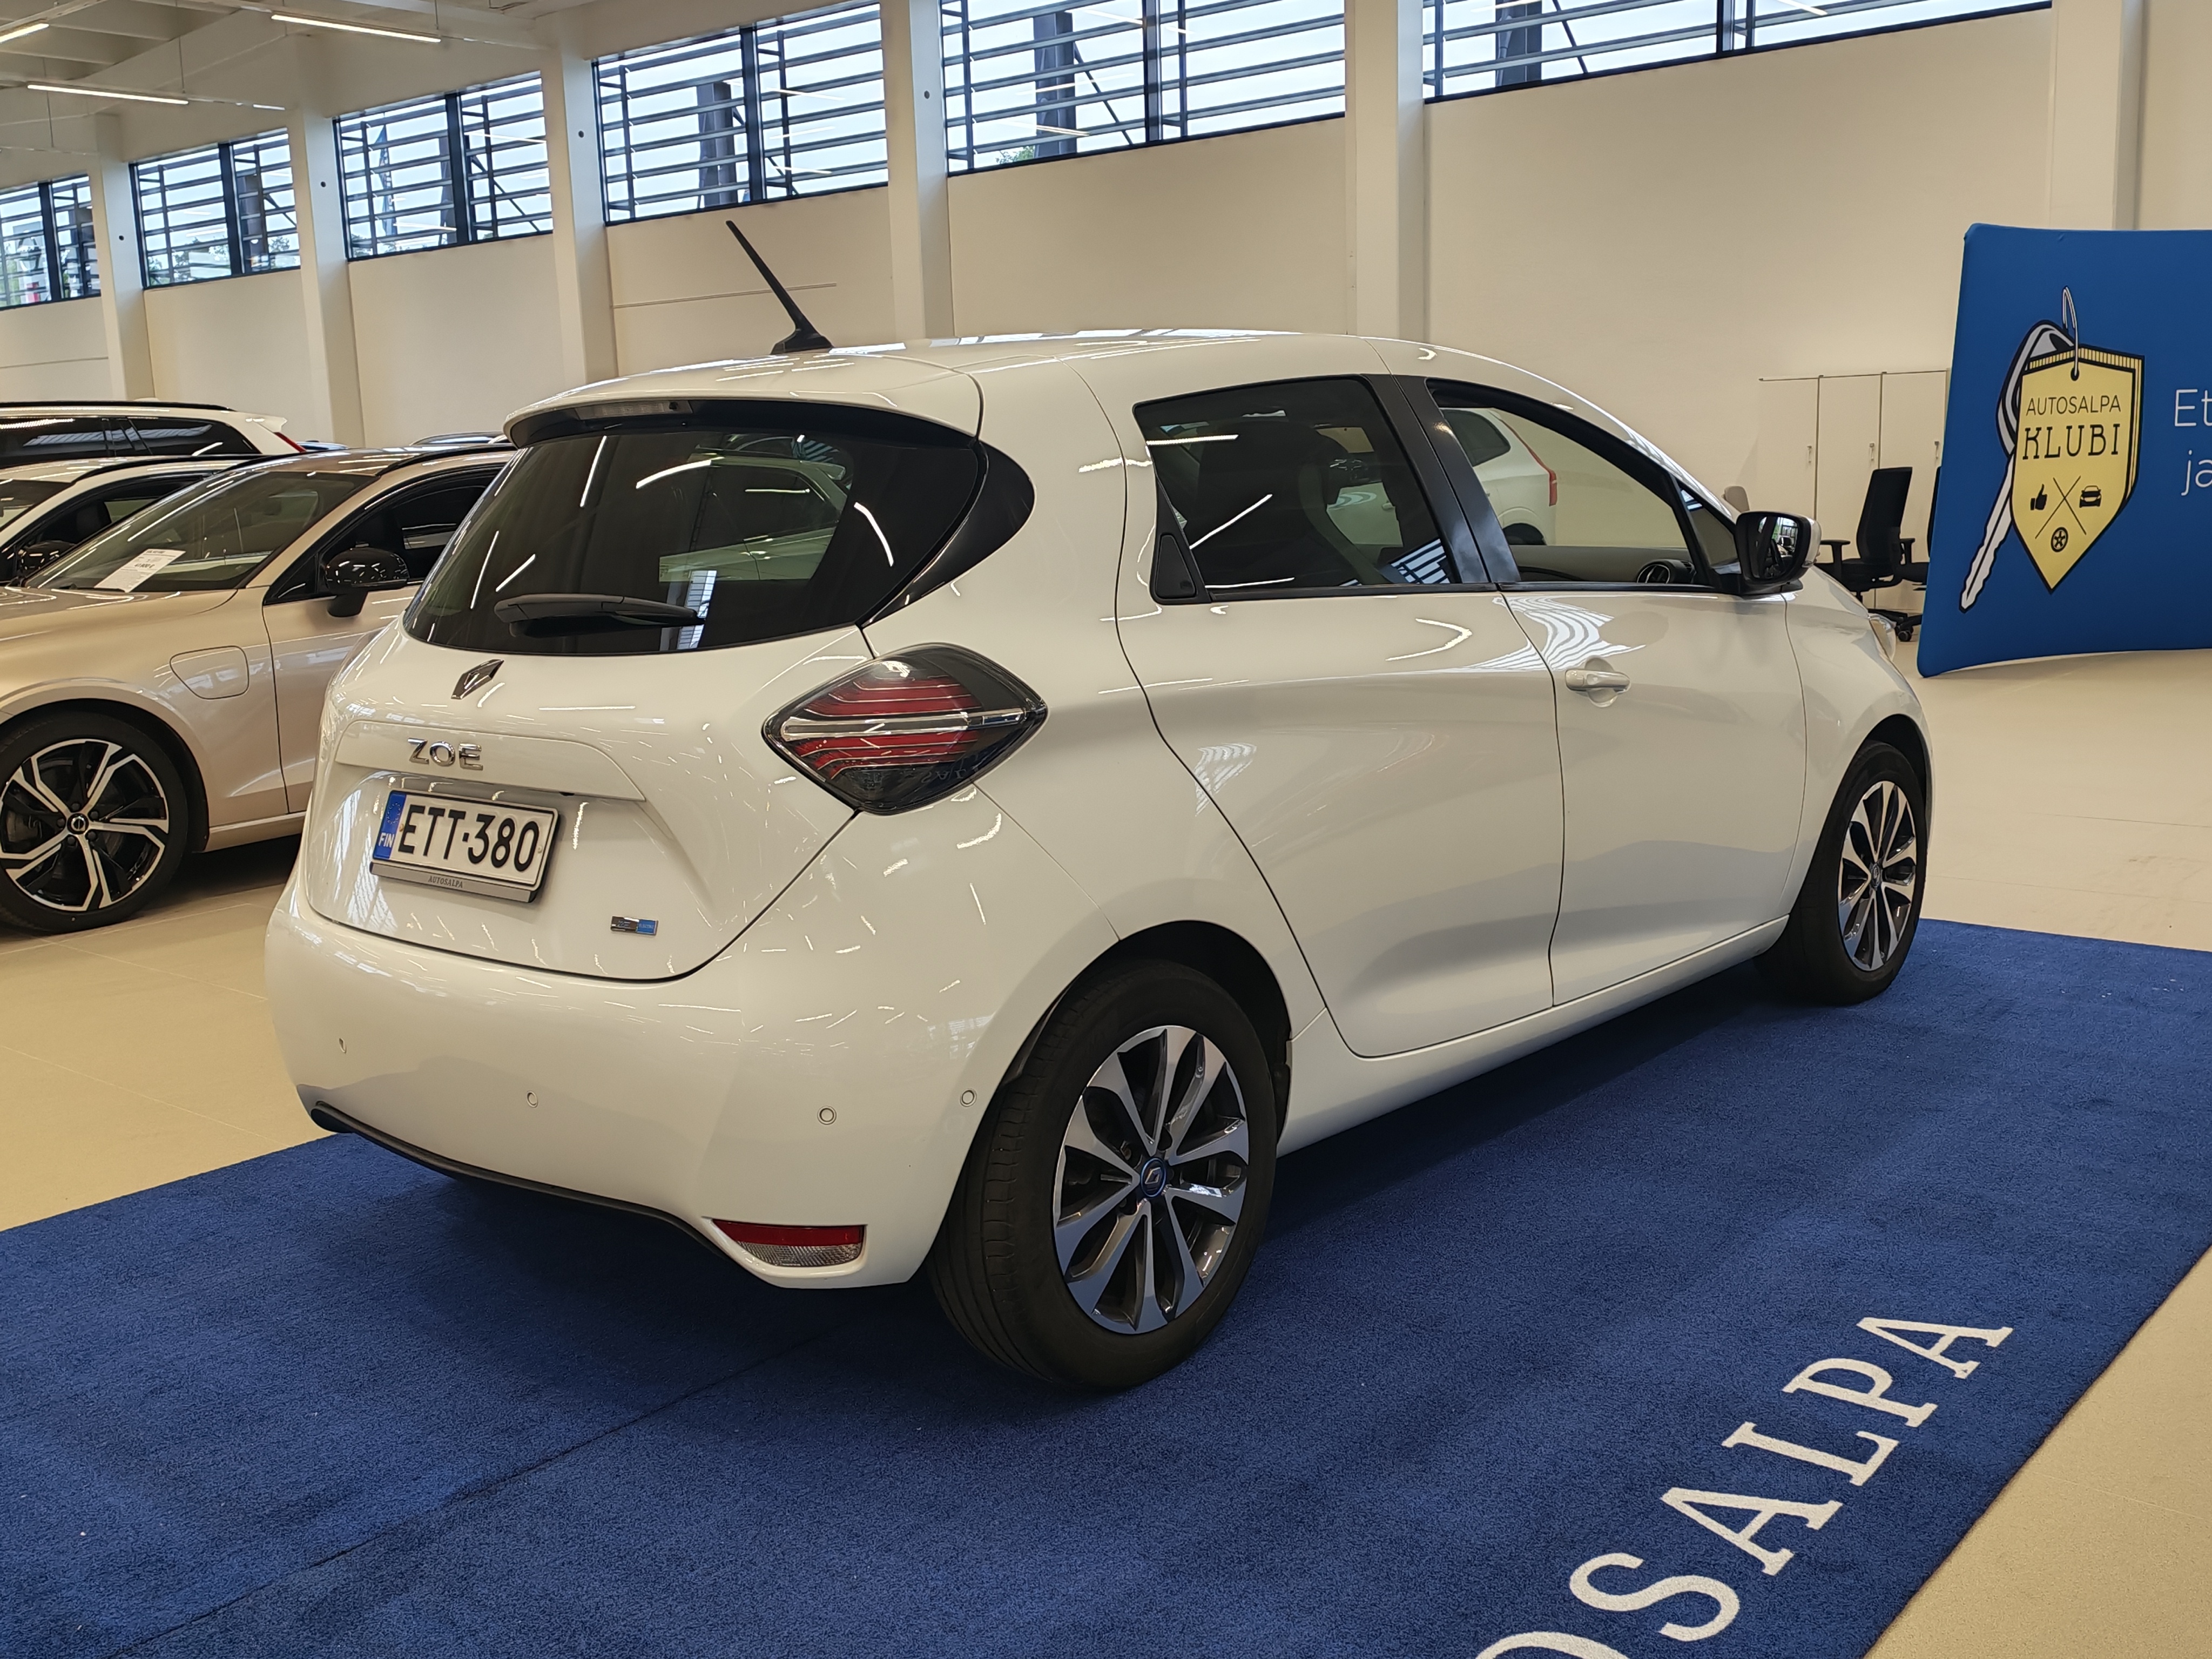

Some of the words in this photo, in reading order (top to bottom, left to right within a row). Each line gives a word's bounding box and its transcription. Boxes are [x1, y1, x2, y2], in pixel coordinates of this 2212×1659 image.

[2026, 395, 2121, 416] AUTOSALPA
[2022, 423, 2120, 460] KLUBI
[408, 738, 483, 771] ZOE
[379, 832, 394, 848] FIN
[428, 875, 463, 888] AUTOSALPA
